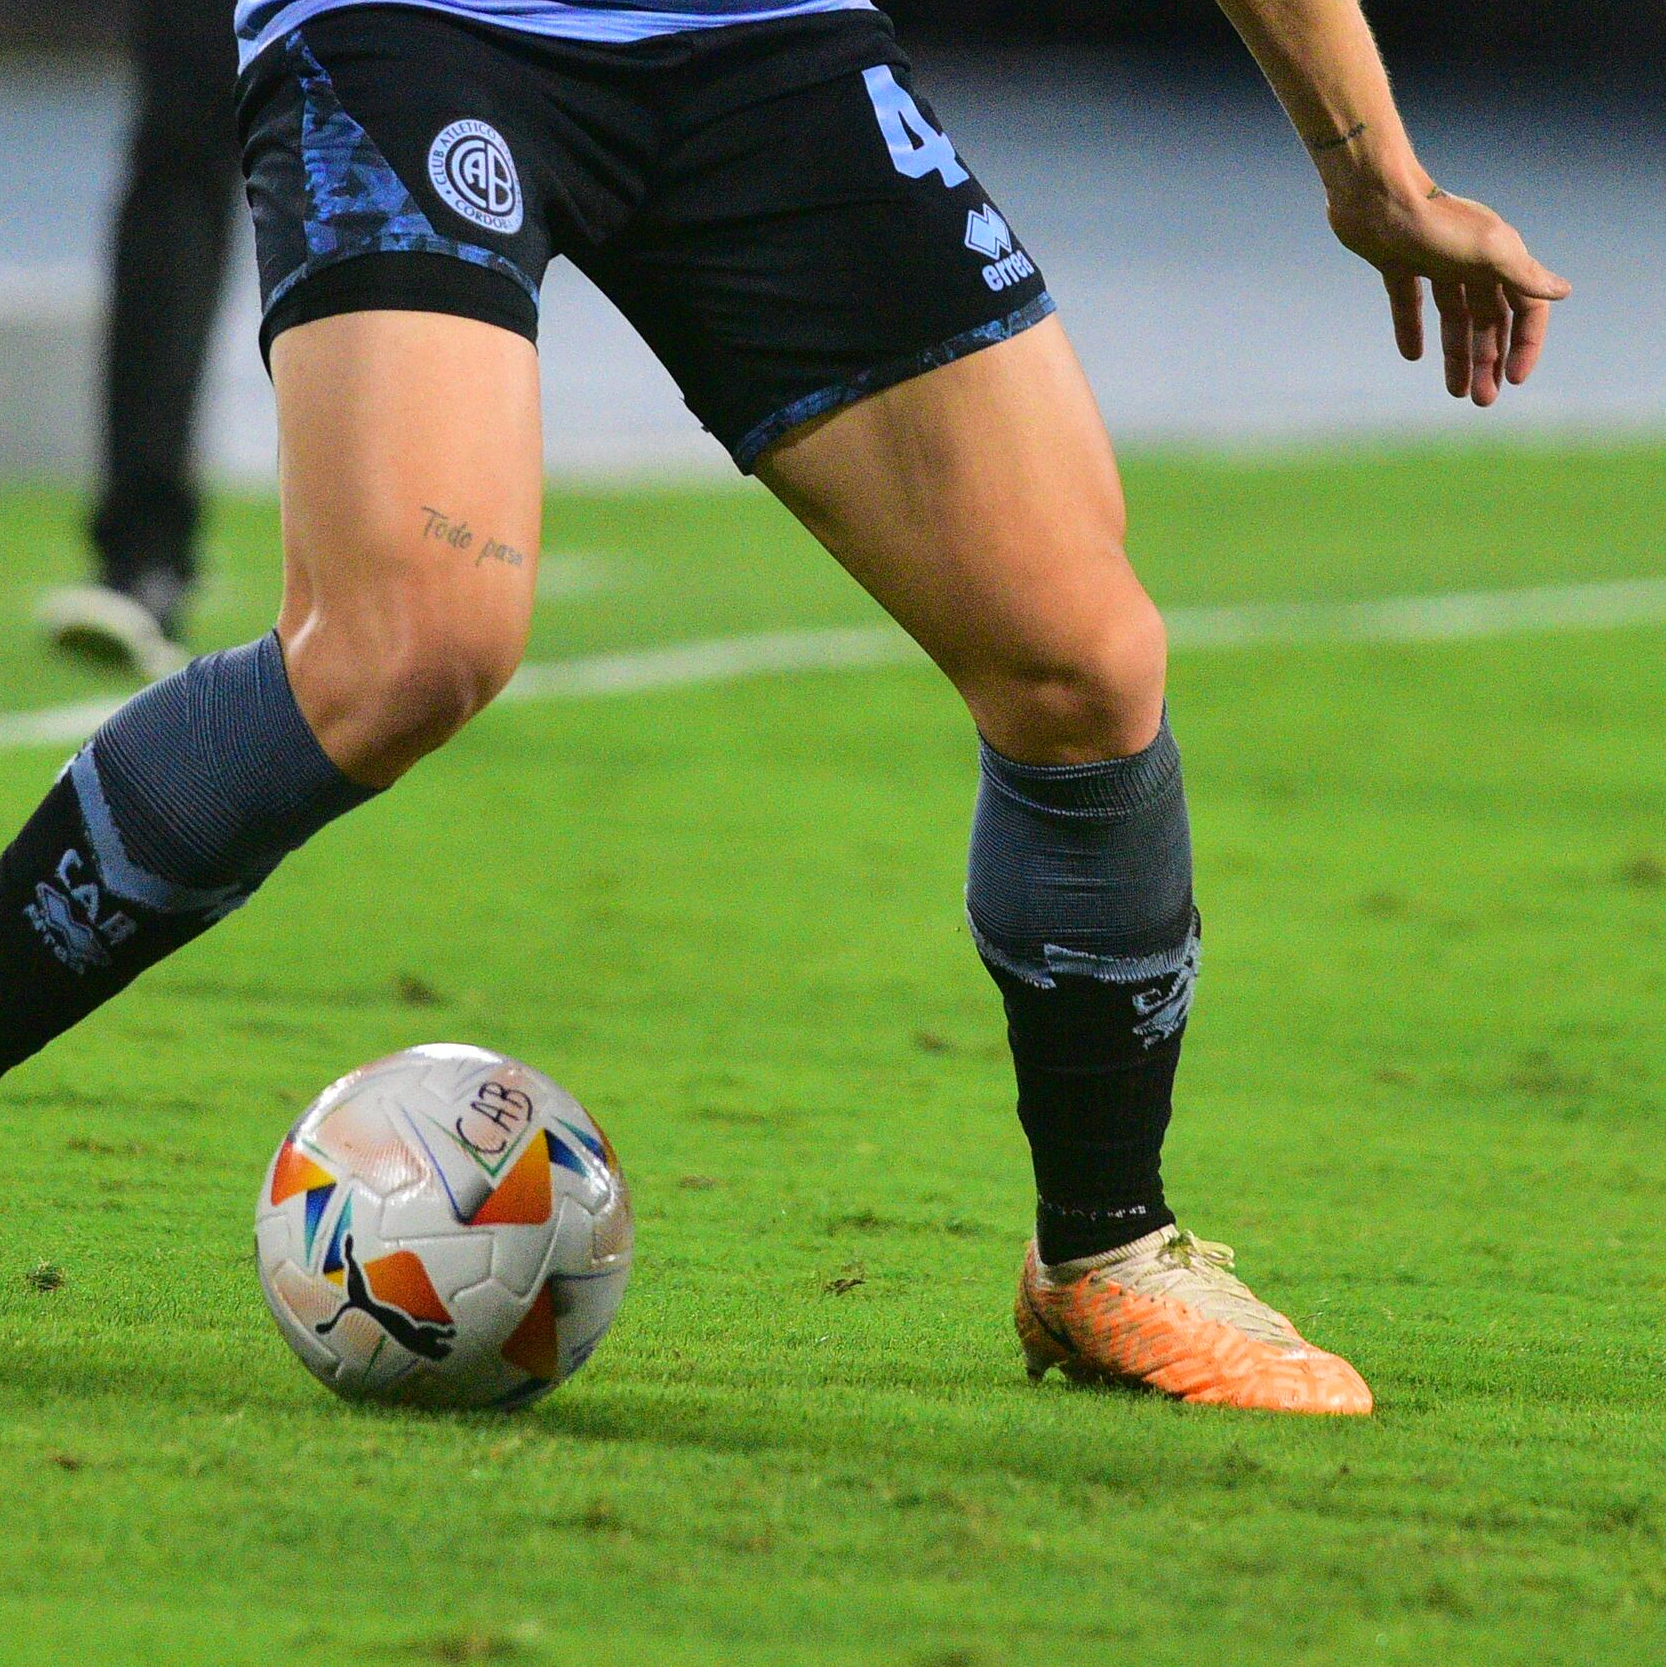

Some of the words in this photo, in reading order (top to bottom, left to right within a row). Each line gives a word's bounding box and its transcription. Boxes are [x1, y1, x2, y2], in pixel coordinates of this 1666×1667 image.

[439, 121, 497, 148] ATLETICO
[861, 63, 970, 189] 4
[431, 149, 448, 186] CLUB
[981, 249, 1035, 292] errea
[419, 505, 473, 549] Todo
[455, 1080, 533, 1154] CAB
